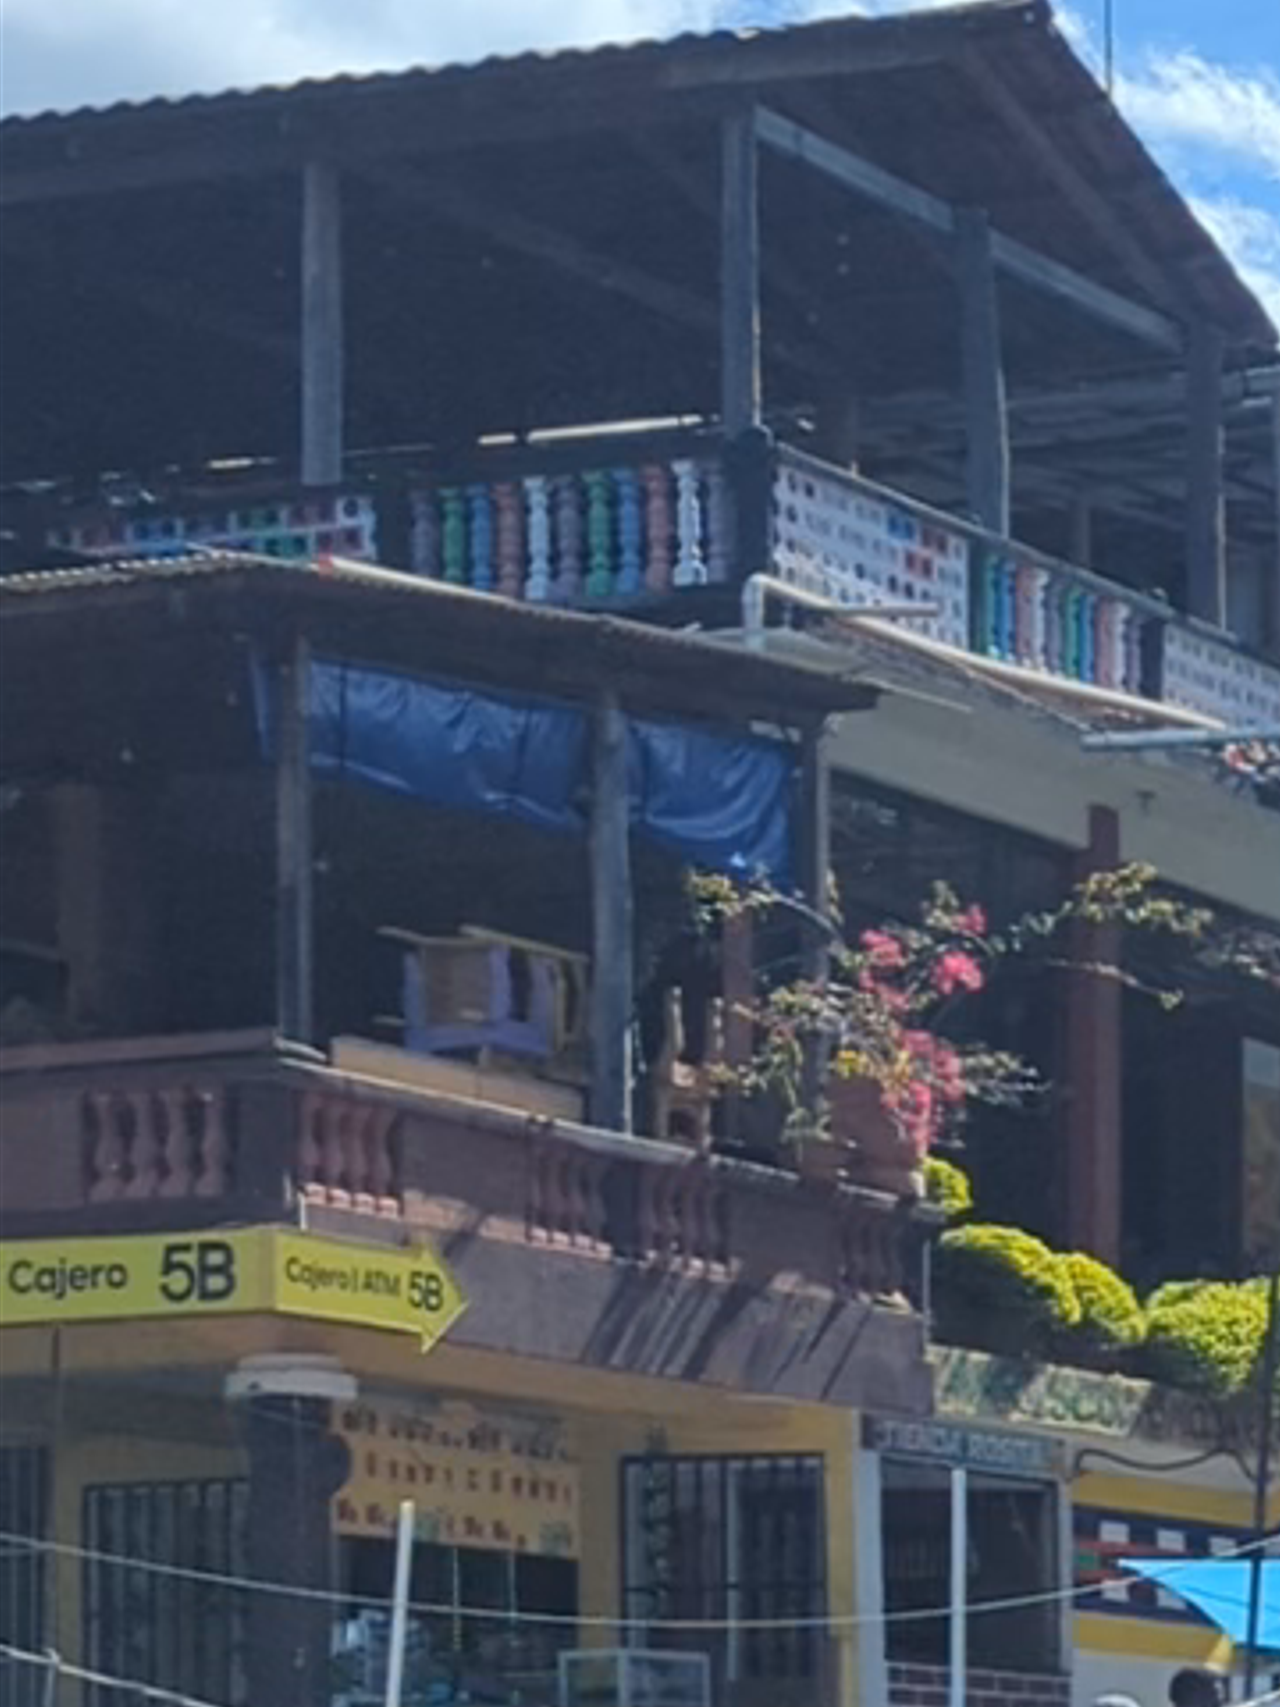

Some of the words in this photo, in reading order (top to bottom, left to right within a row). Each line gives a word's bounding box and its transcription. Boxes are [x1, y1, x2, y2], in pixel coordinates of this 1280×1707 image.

[8, 1257, 129, 1300] Cajero
[158, 1239, 238, 1304] 5B
[285, 1255, 348, 1294] Cajero
[406, 1269, 446, 1312] 5B
